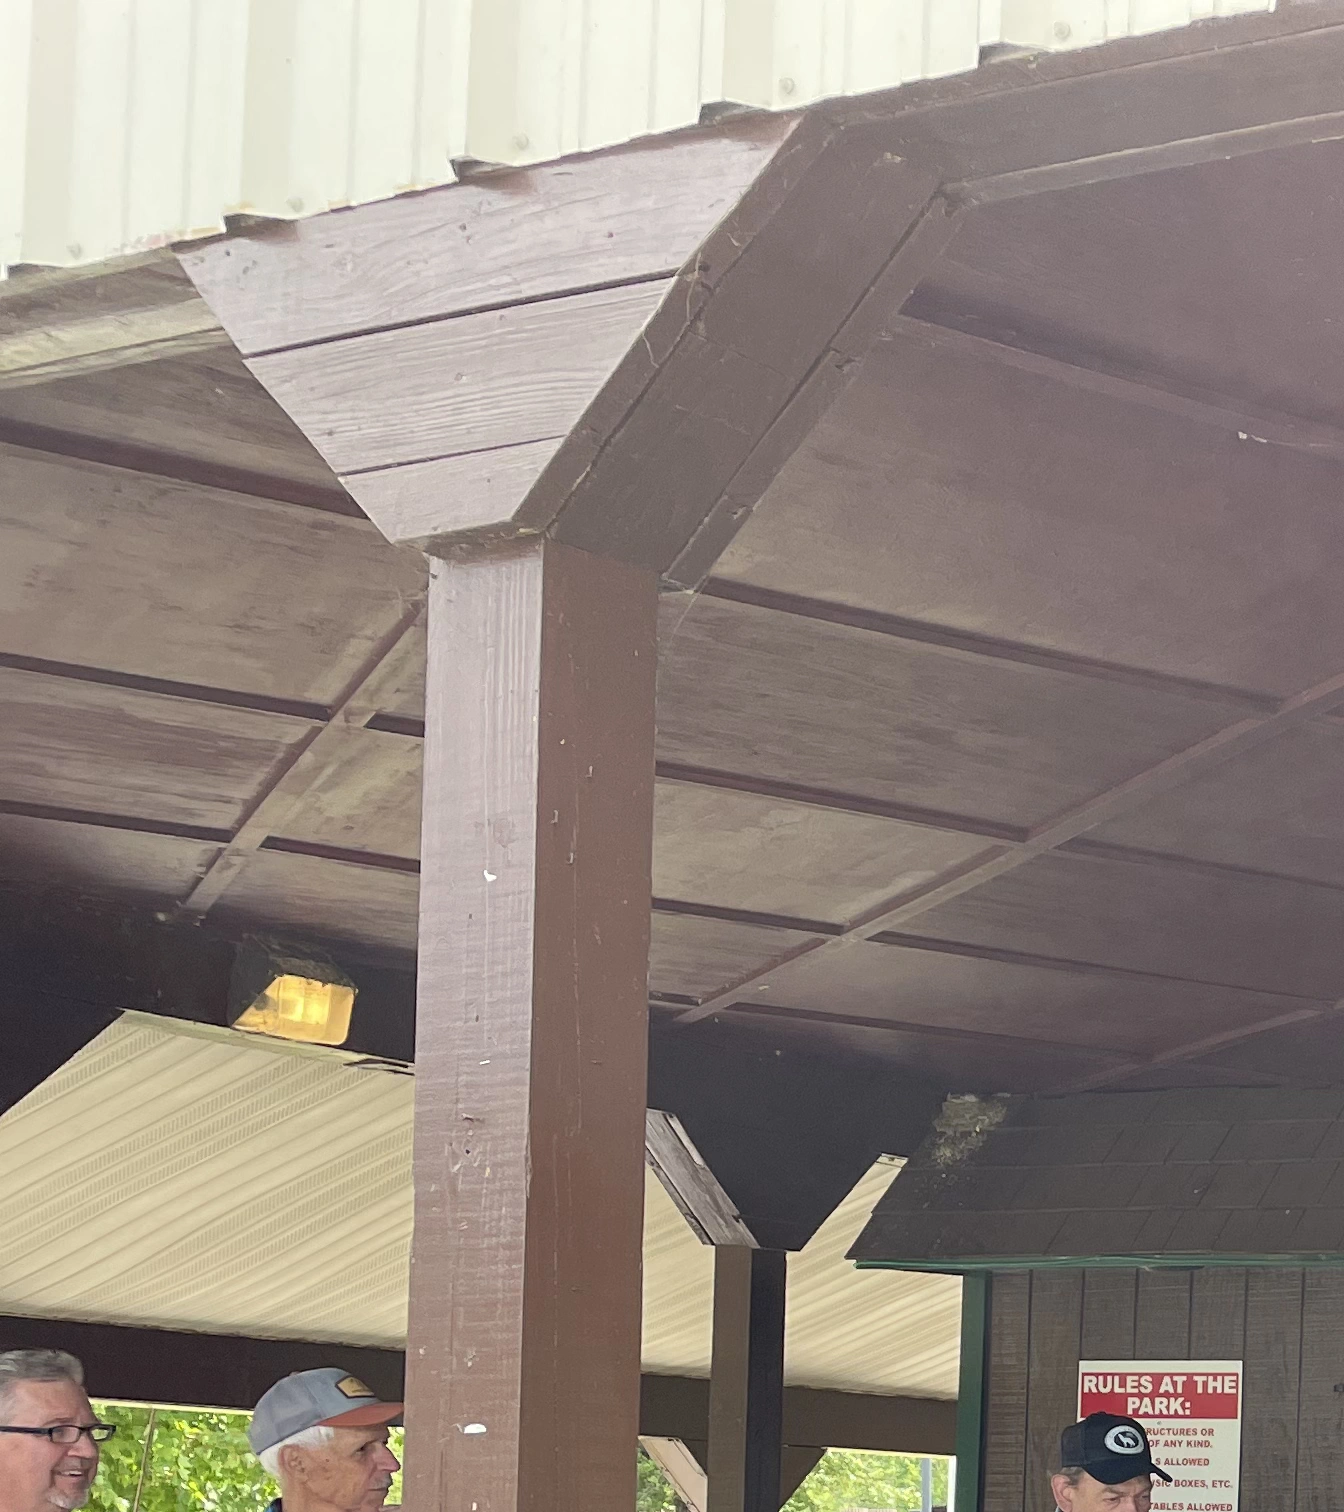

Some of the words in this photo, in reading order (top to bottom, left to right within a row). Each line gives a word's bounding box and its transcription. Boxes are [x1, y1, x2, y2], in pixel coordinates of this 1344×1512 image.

[1083, 1375, 1153, 1394] RULES
[1159, 1375, 1187, 1394] AT
[1193, 1375, 1237, 1394] THE
[1127, 1397, 1191, 1415] PARK:
[1146, 1427, 1198, 1436] RUCTURES
[1200, 1427, 1215, 1436] OR
[1149, 1439, 1161, 1448] OF
[1163, 1440, 1184, 1448] ANY
[1186, 1440, 1213, 1448] KIND.
[1163, 1457, 1210, 1467] ALLOWED
[1173, 1480, 1209, 1489] BOXES,
[1212, 1480, 1233, 1488] ETC.
[1187, 1503, 1233, 1512] ALLOWED
